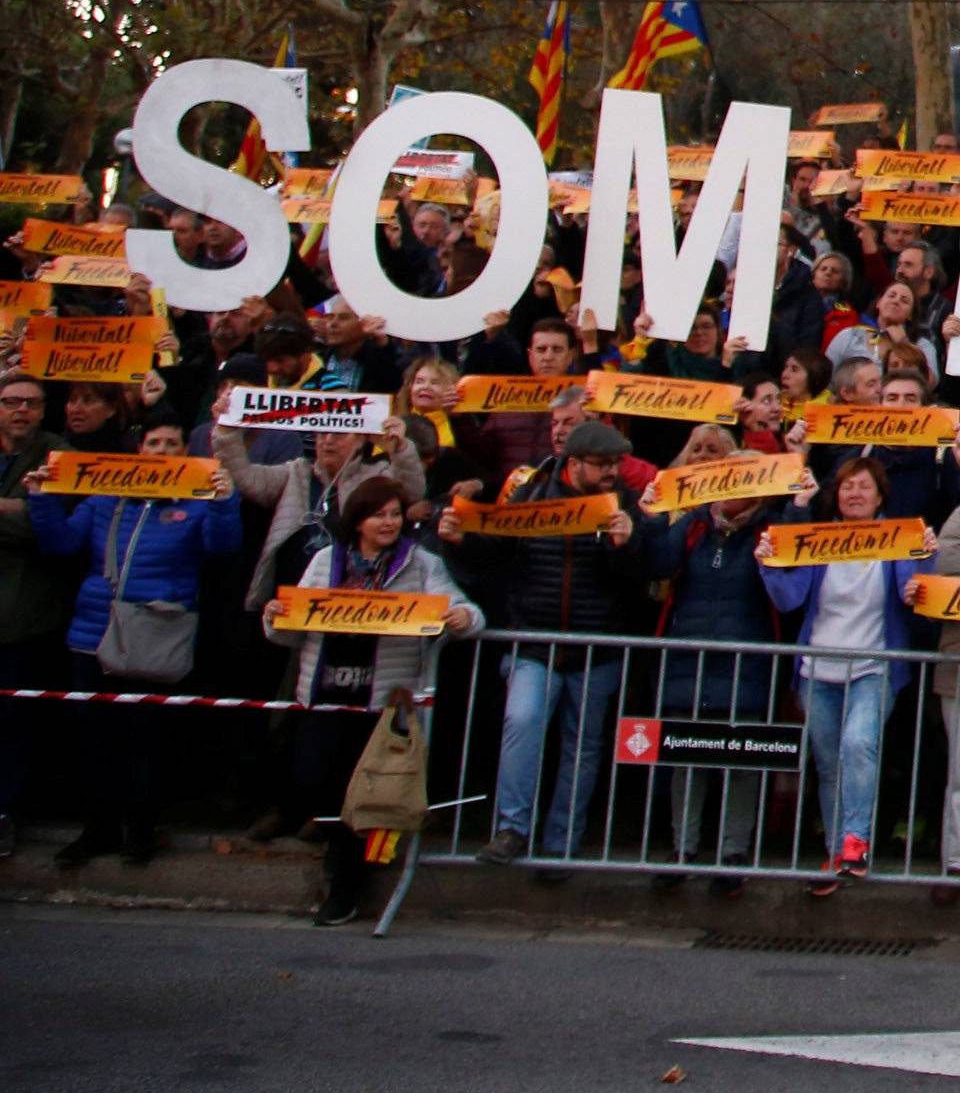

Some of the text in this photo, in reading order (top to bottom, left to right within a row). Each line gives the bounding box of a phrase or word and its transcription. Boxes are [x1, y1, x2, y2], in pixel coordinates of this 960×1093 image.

[126, 58, 792, 351] SOM
[43, 347, 124, 378] Llibertat!
[244, 393, 367, 415] LLIBERTAT
[609, 385, 713, 411] Freedom!
[300, 415, 365, 429] POLÍTICS!
[831, 413, 930, 439] Freedom!
[73, 462, 188, 490] Freedom!
[675, 460, 779, 505] Freedom!
[478, 503, 587, 532] Freedom!
[793, 525, 901, 563] Freedom!
[303, 598, 418, 626] Freedom!
[663, 735, 798, 754] Ajuntament de Barcelona
